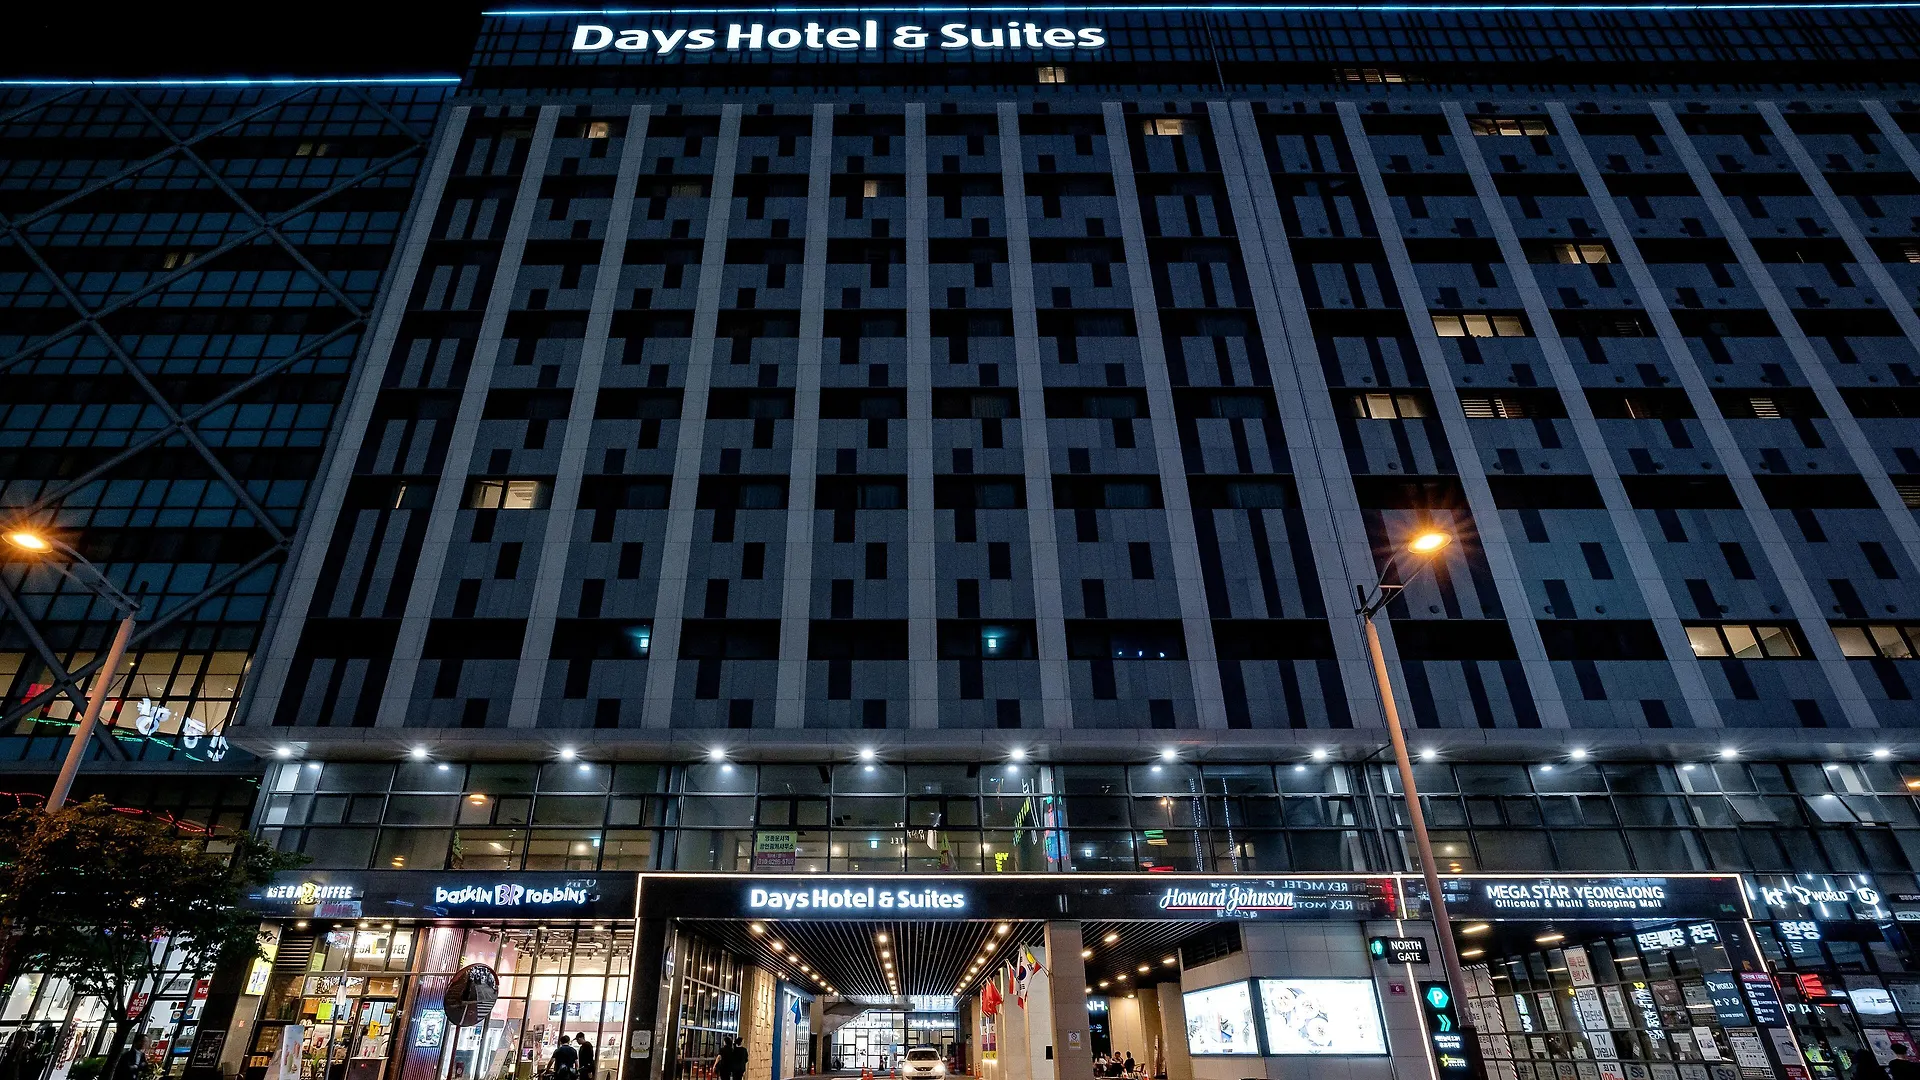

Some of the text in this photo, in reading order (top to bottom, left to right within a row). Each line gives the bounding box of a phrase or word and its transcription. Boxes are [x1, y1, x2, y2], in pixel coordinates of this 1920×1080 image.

[572, 19, 1106, 56] Days Hotel & Suites
[315, 886, 353, 898] COFFEE
[435, 885, 493, 905] baskin
[494, 884, 525, 905] BR
[525, 886, 587, 904] robbins
[1486, 886, 1665, 899] MEGA STAR YEONGJONG
[1761, 886, 1788, 906] kt
[1810, 890, 1849, 902] WORLD
[751, 888, 965, 910] Days Hotel & Suites
[1159, 887, 1294, 911] Howard Johnson
[1495, 899, 1662, 909] Officetel & Multi Shopping Mall
[1390, 941, 1422, 950] NORTH
[1397, 952, 1421, 961] GATE
[1432, 990, 1443, 1004] P
[1595, 1034, 1606, 1045] TV
